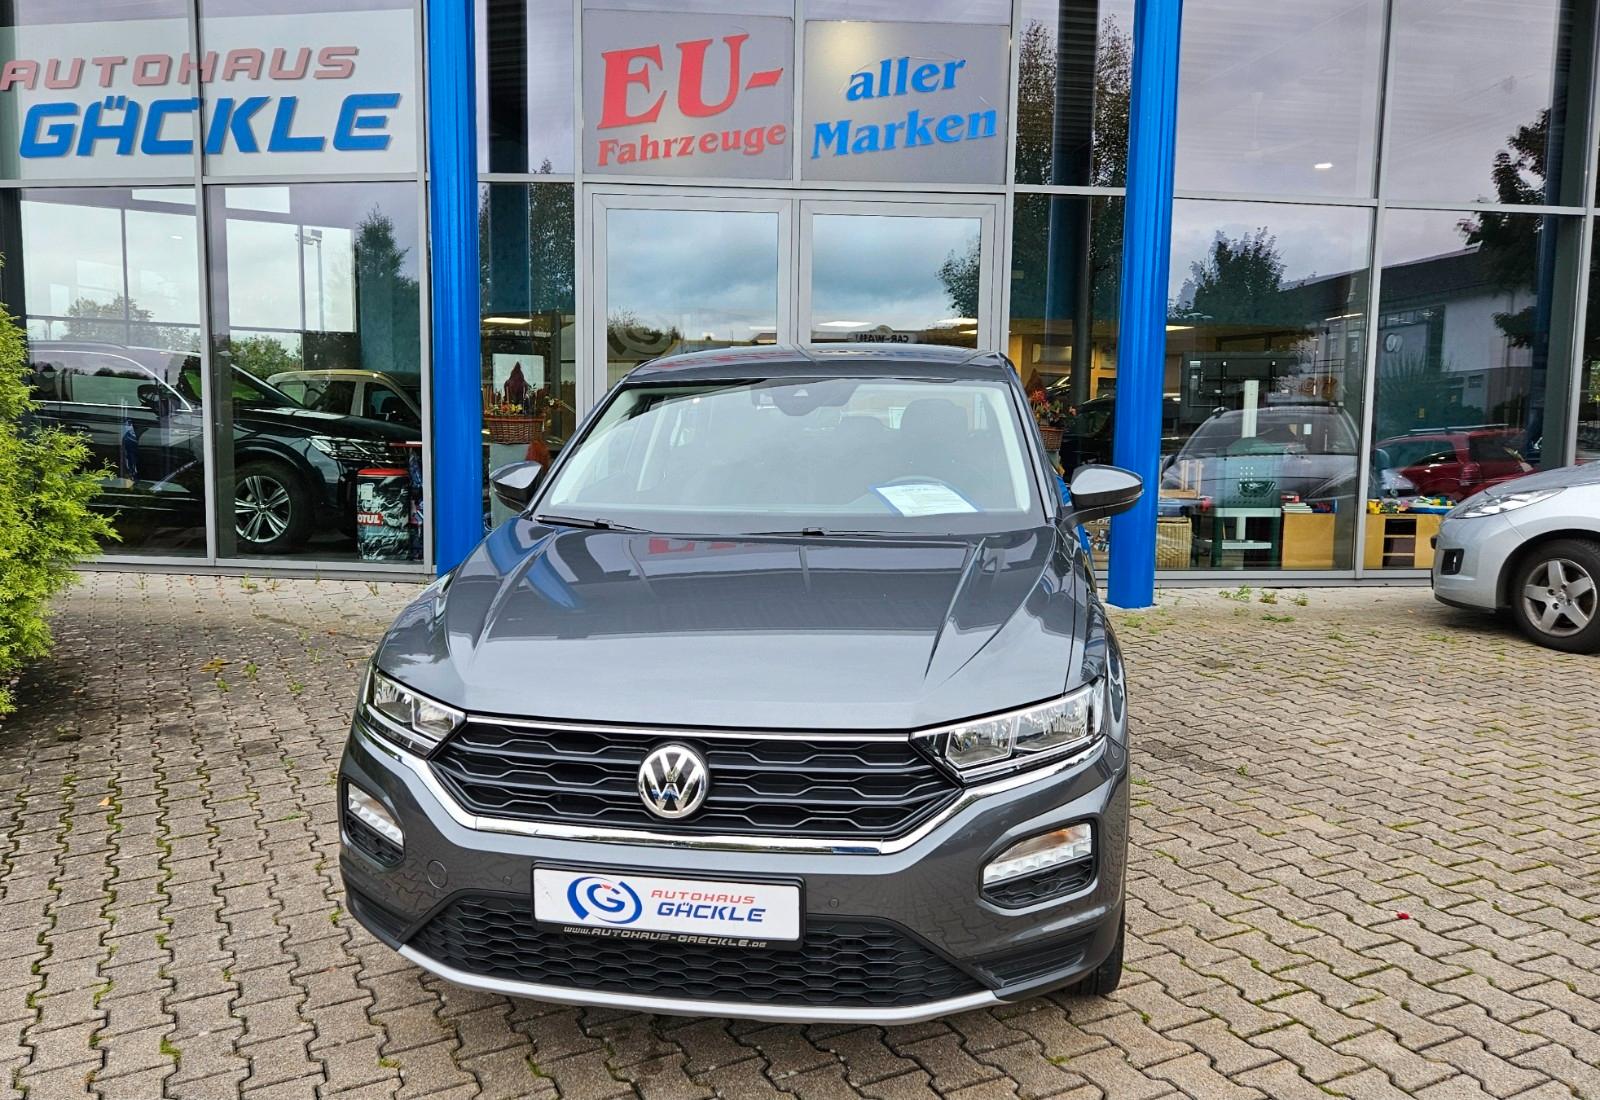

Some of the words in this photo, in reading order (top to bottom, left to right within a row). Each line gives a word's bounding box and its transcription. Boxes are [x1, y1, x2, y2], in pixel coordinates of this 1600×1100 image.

[0, 46, 360, 91] AUTOHAUS
[597, 34, 784, 130] EU-
[846, 56, 966, 102] aller
[19, 93, 401, 158] GÄCKLE
[597, 122, 787, 167] Fahrzeuge
[810, 108, 998, 159] Marken
[357, 514, 380, 524] OTUL
[650, 889, 756, 905] AUTOHAUS
[656, 902, 766, 923] GÄCKLE
